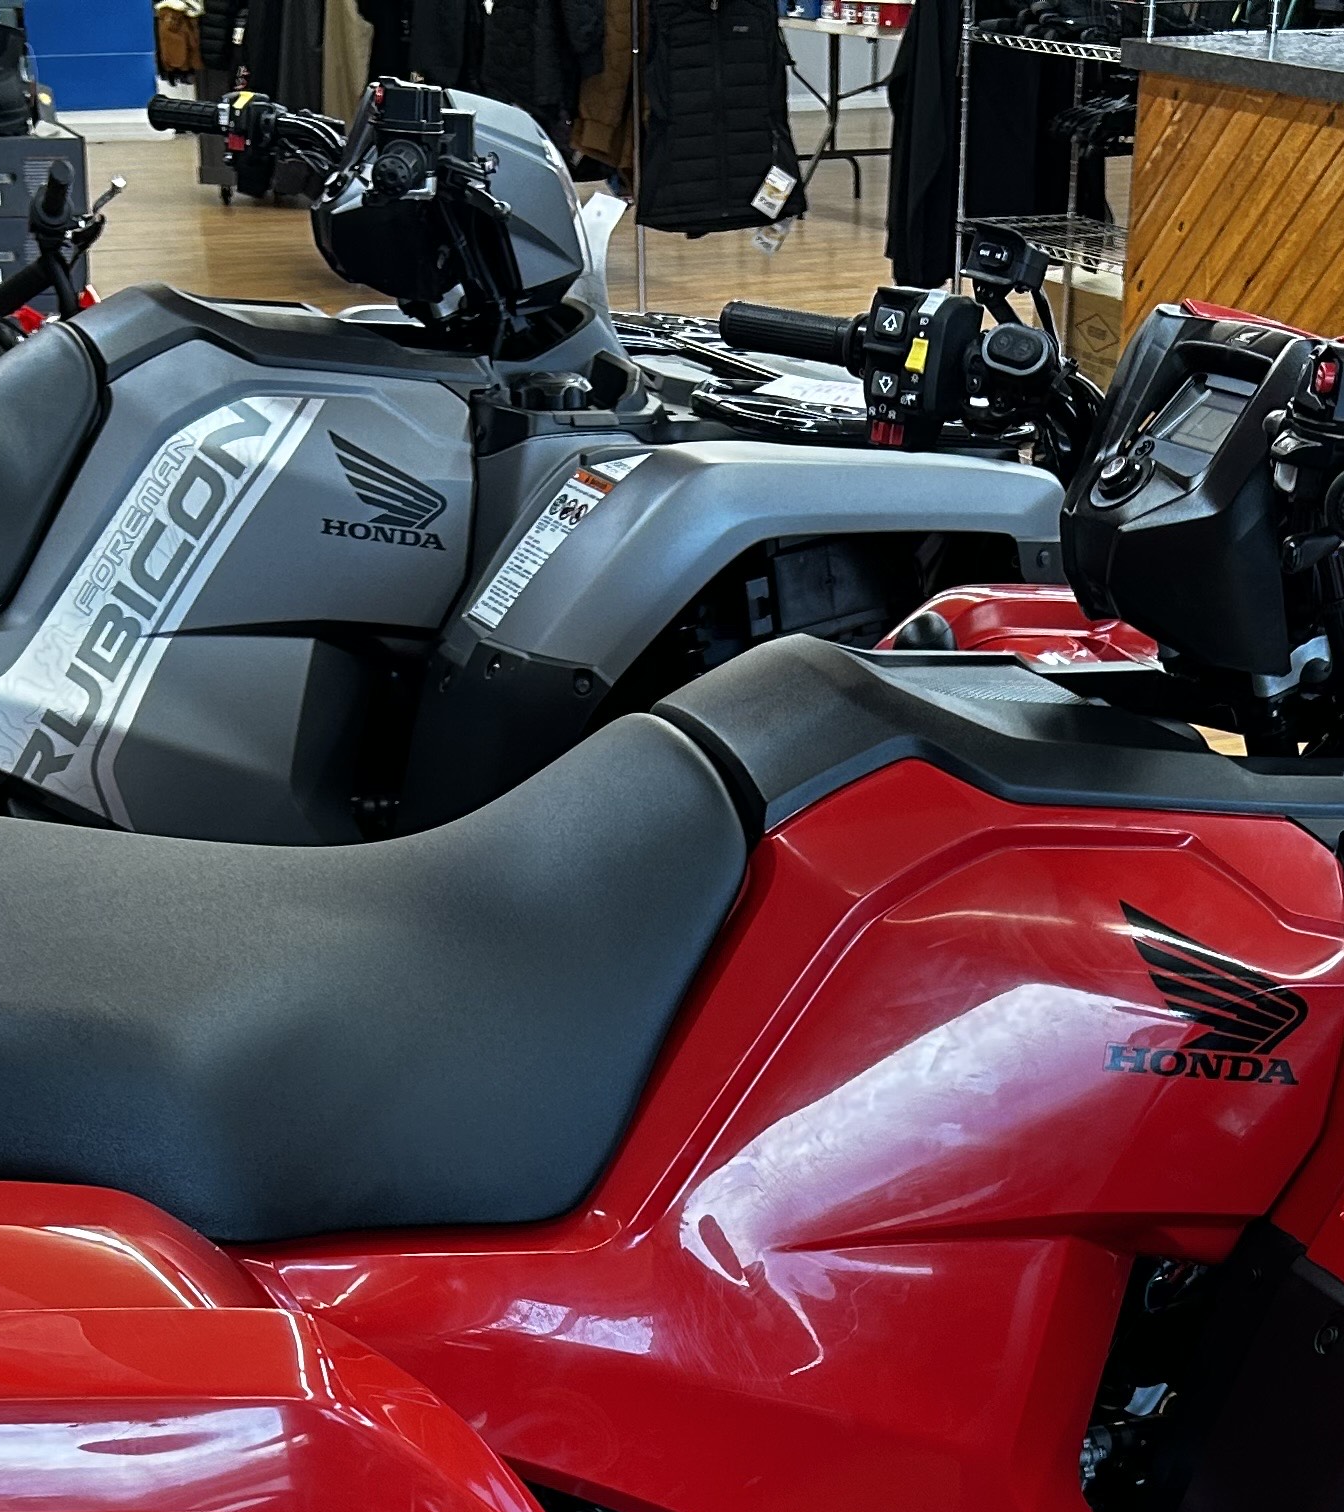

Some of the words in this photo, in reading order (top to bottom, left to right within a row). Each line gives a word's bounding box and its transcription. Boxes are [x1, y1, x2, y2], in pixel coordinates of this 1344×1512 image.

[74, 431, 197, 616] FOREMAN
[321, 517, 447, 552] HONDA
[13, 402, 276, 787] RUBICON
[1102, 1041, 1300, 1087] HONDA
